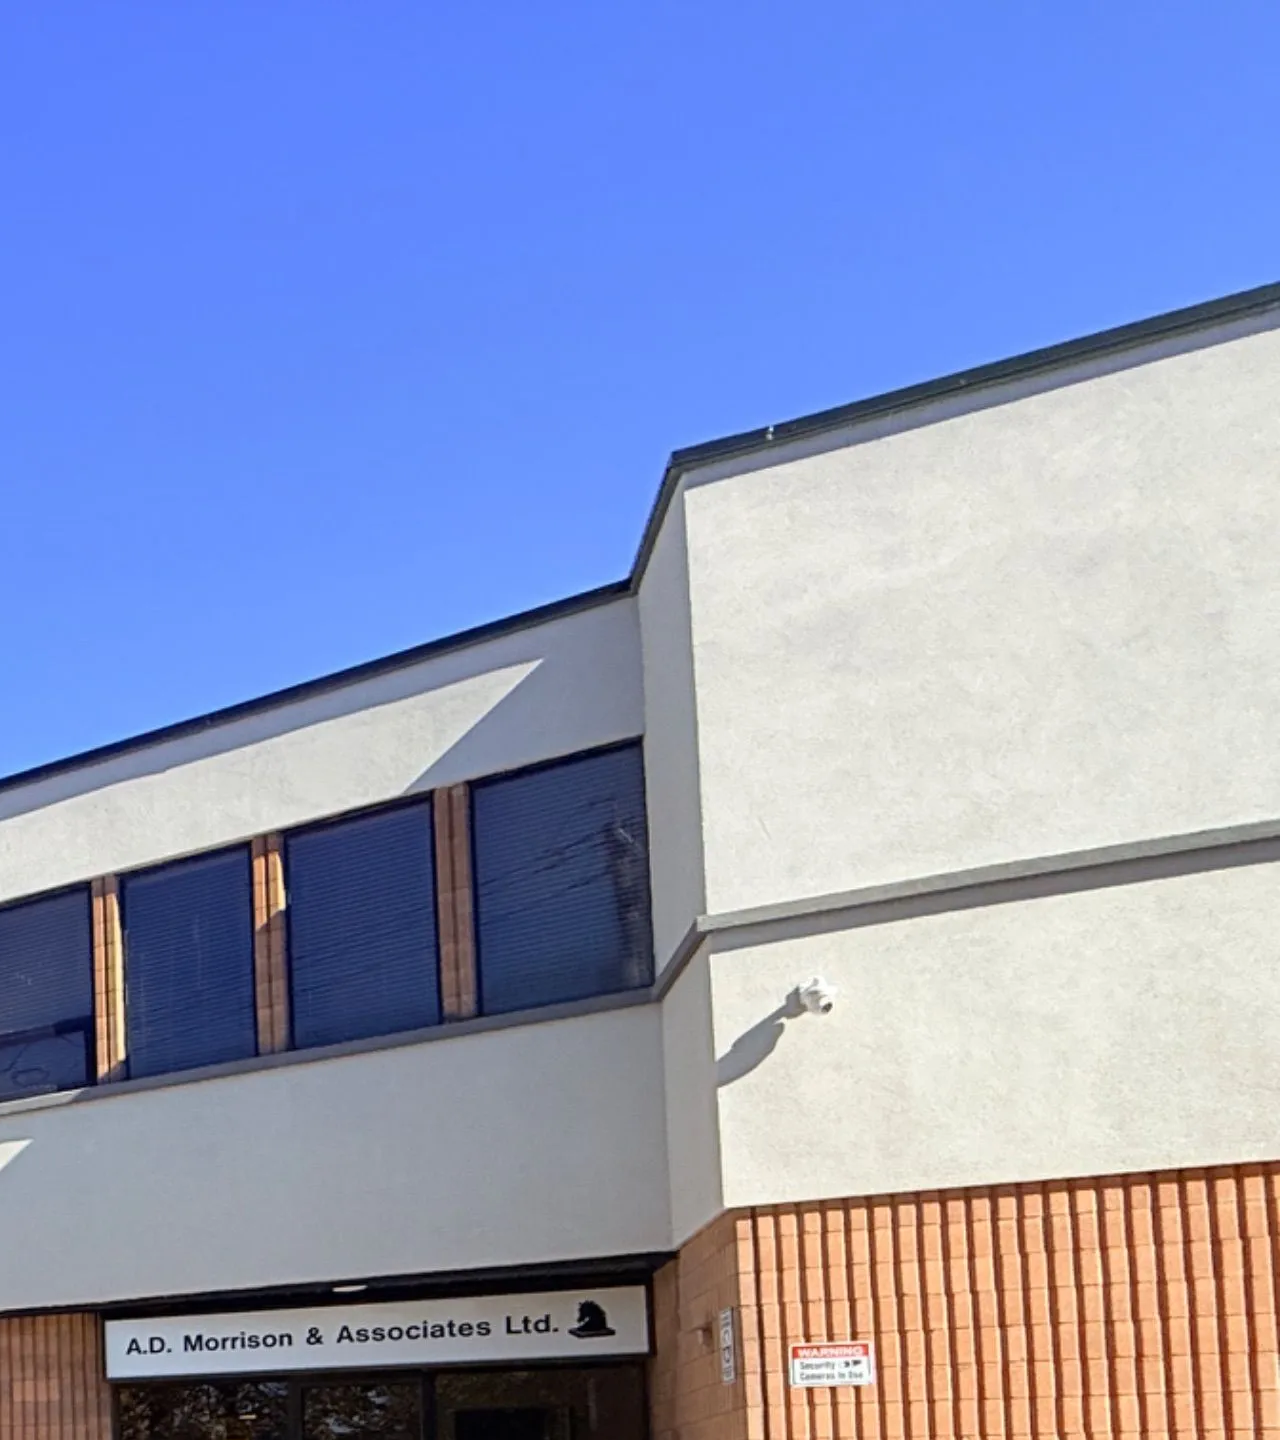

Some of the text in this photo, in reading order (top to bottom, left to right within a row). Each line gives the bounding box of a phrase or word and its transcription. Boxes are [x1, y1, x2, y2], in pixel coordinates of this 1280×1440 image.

[126, 1314, 559, 1355] A.D. Morrison & Associates Ltd.
[797, 1346, 864, 1358] WARNING
